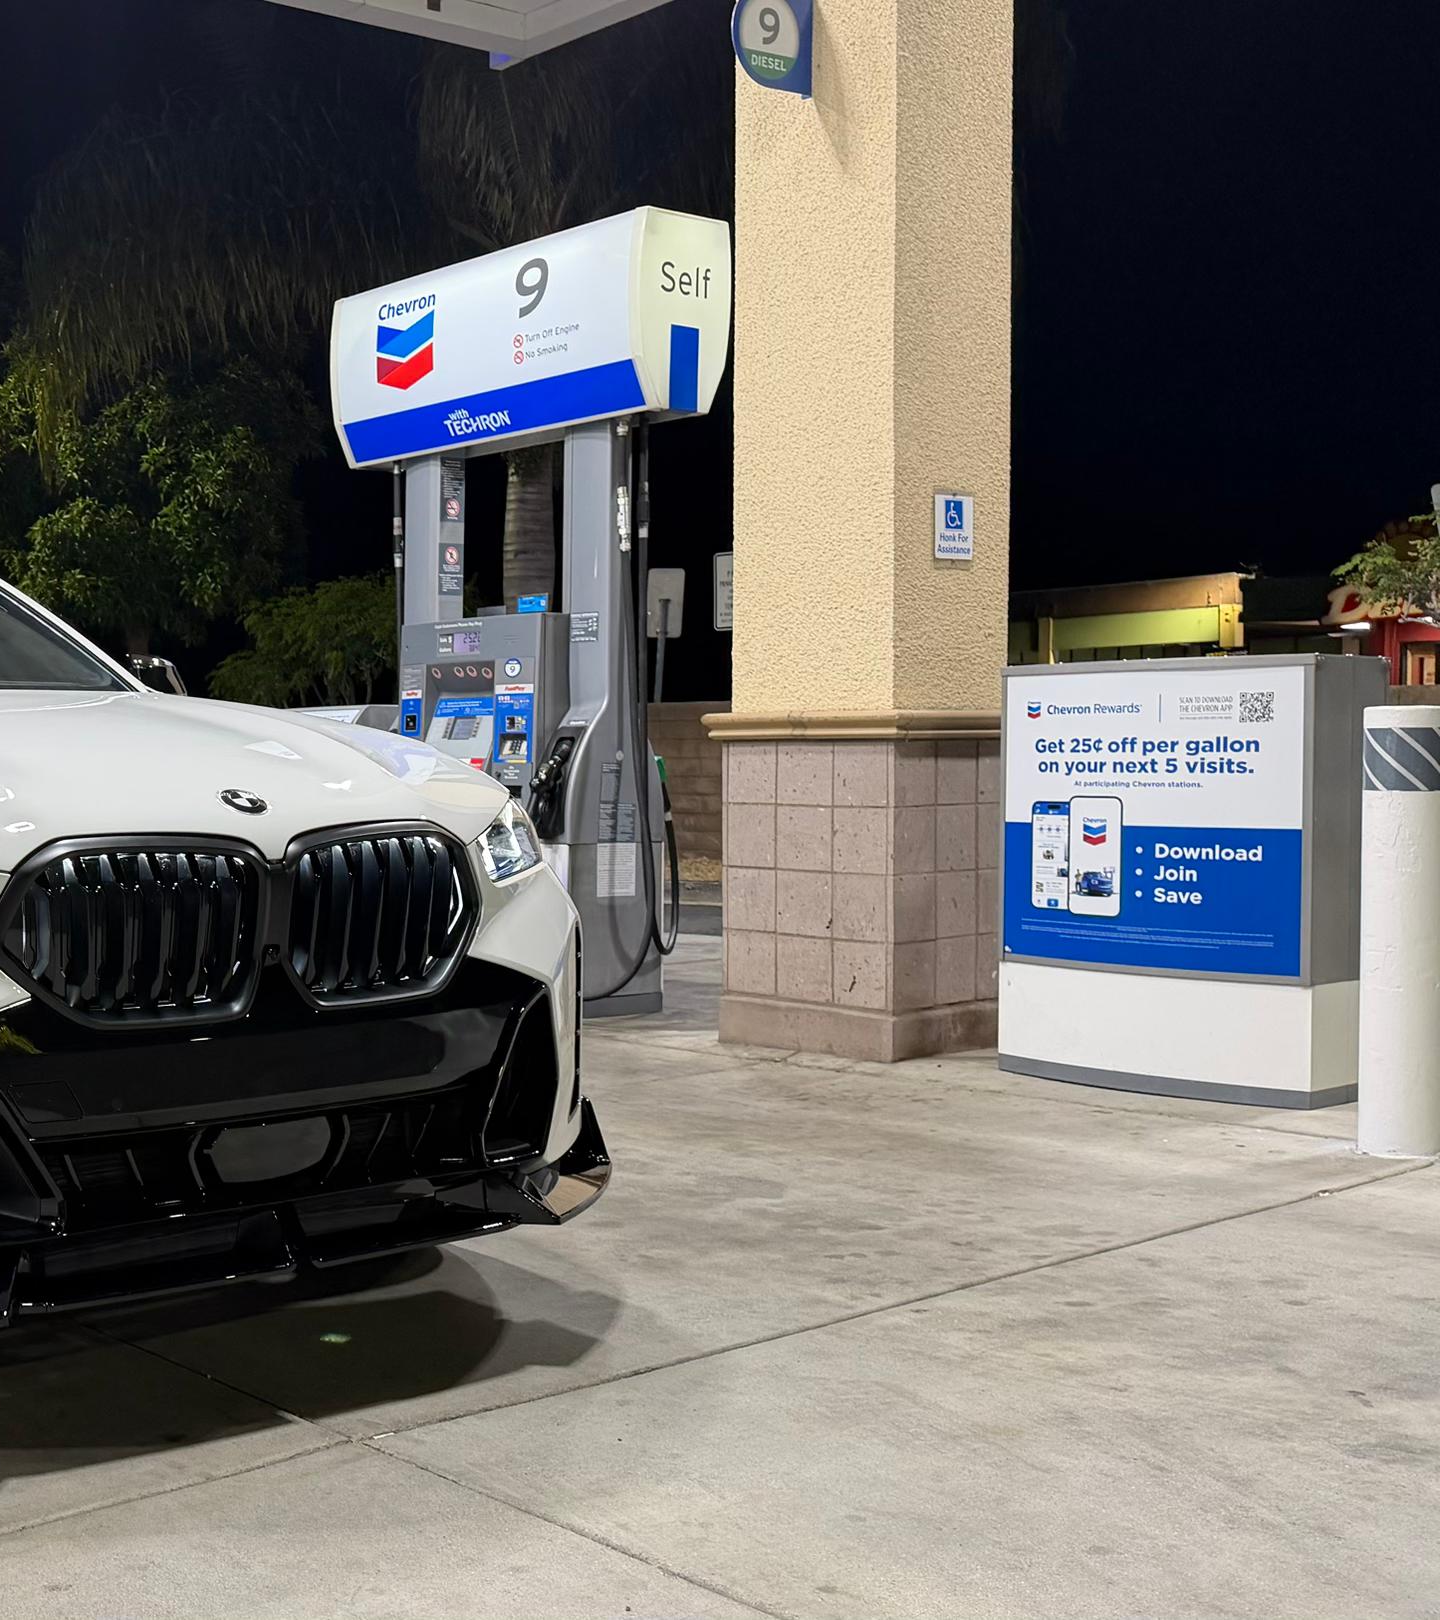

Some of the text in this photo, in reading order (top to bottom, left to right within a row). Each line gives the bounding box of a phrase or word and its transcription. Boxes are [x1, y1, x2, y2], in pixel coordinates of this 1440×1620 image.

[759, 7, 780, 45] 9
[751, 53, 787, 72] DIESEL
[515, 258, 549, 318] 9
[661, 261, 711, 300] Self
[378, 292, 436, 321] Chevron
[524, 323, 580, 343] Turn Off Engine
[525, 343, 568, 359] No Smoking
[443, 410, 511, 437] TECHRON
[448, 408, 469, 421] with
[957, 533, 969, 543] For
[937, 544, 971, 555] Assistance
[1047, 703, 1140, 715] Chevron Rewards
[1035, 736, 1260, 756] Get 25¢ off per gallon
[1038, 757, 1254, 776] on your next 5 visits.
[1082, 816, 1107, 824] Chevron
[1154, 843, 1262, 861] Download
[1154, 865, 1197, 882] Join
[1154, 887, 1202, 904] Save
